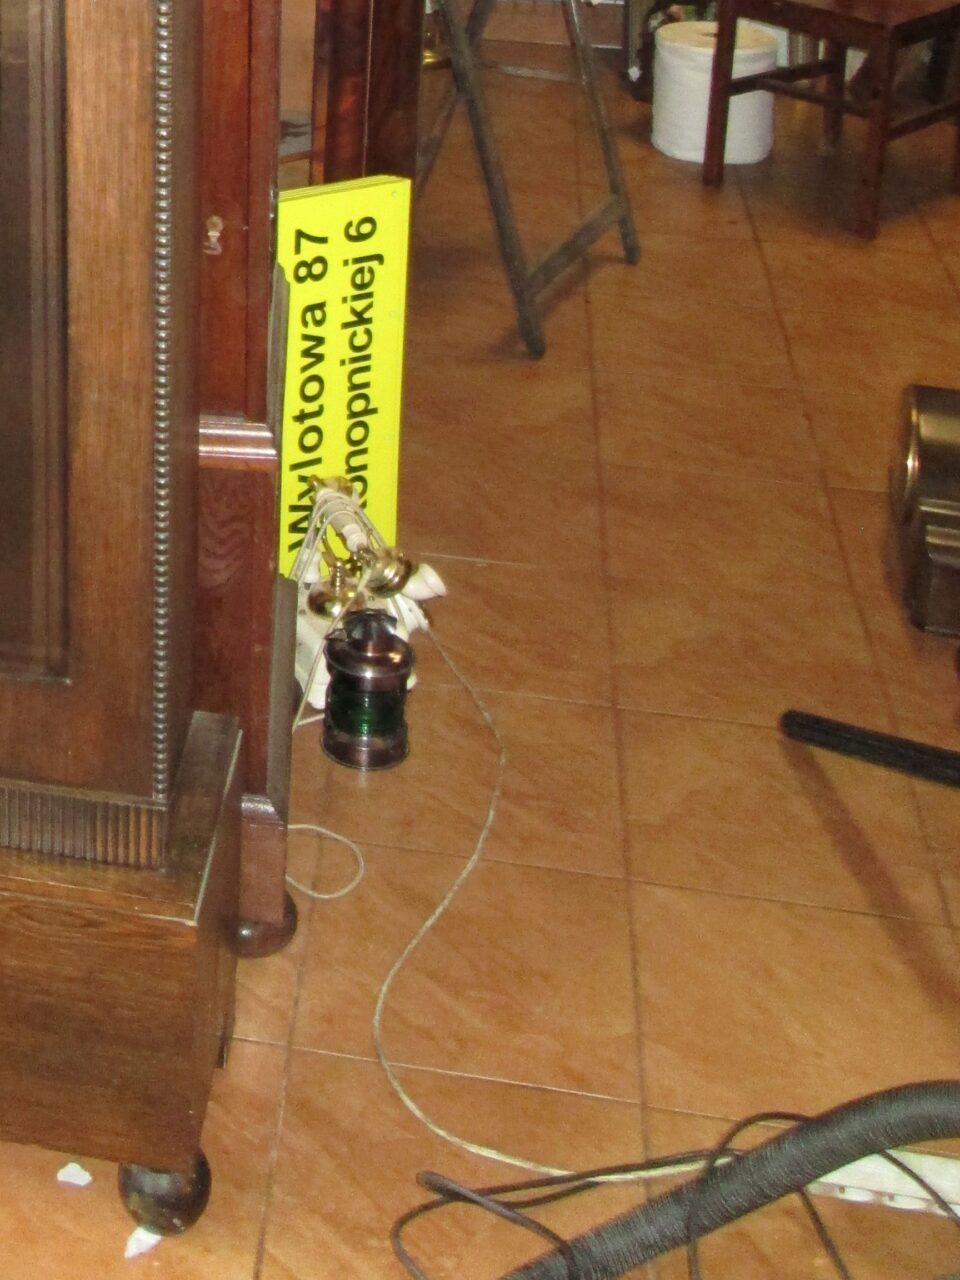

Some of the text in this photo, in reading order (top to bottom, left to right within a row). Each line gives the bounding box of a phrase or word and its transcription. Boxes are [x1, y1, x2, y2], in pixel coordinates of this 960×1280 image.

[288, 228, 329, 554] Wylotowa 87
[339, 216, 385, 510] onopnickiej 6
